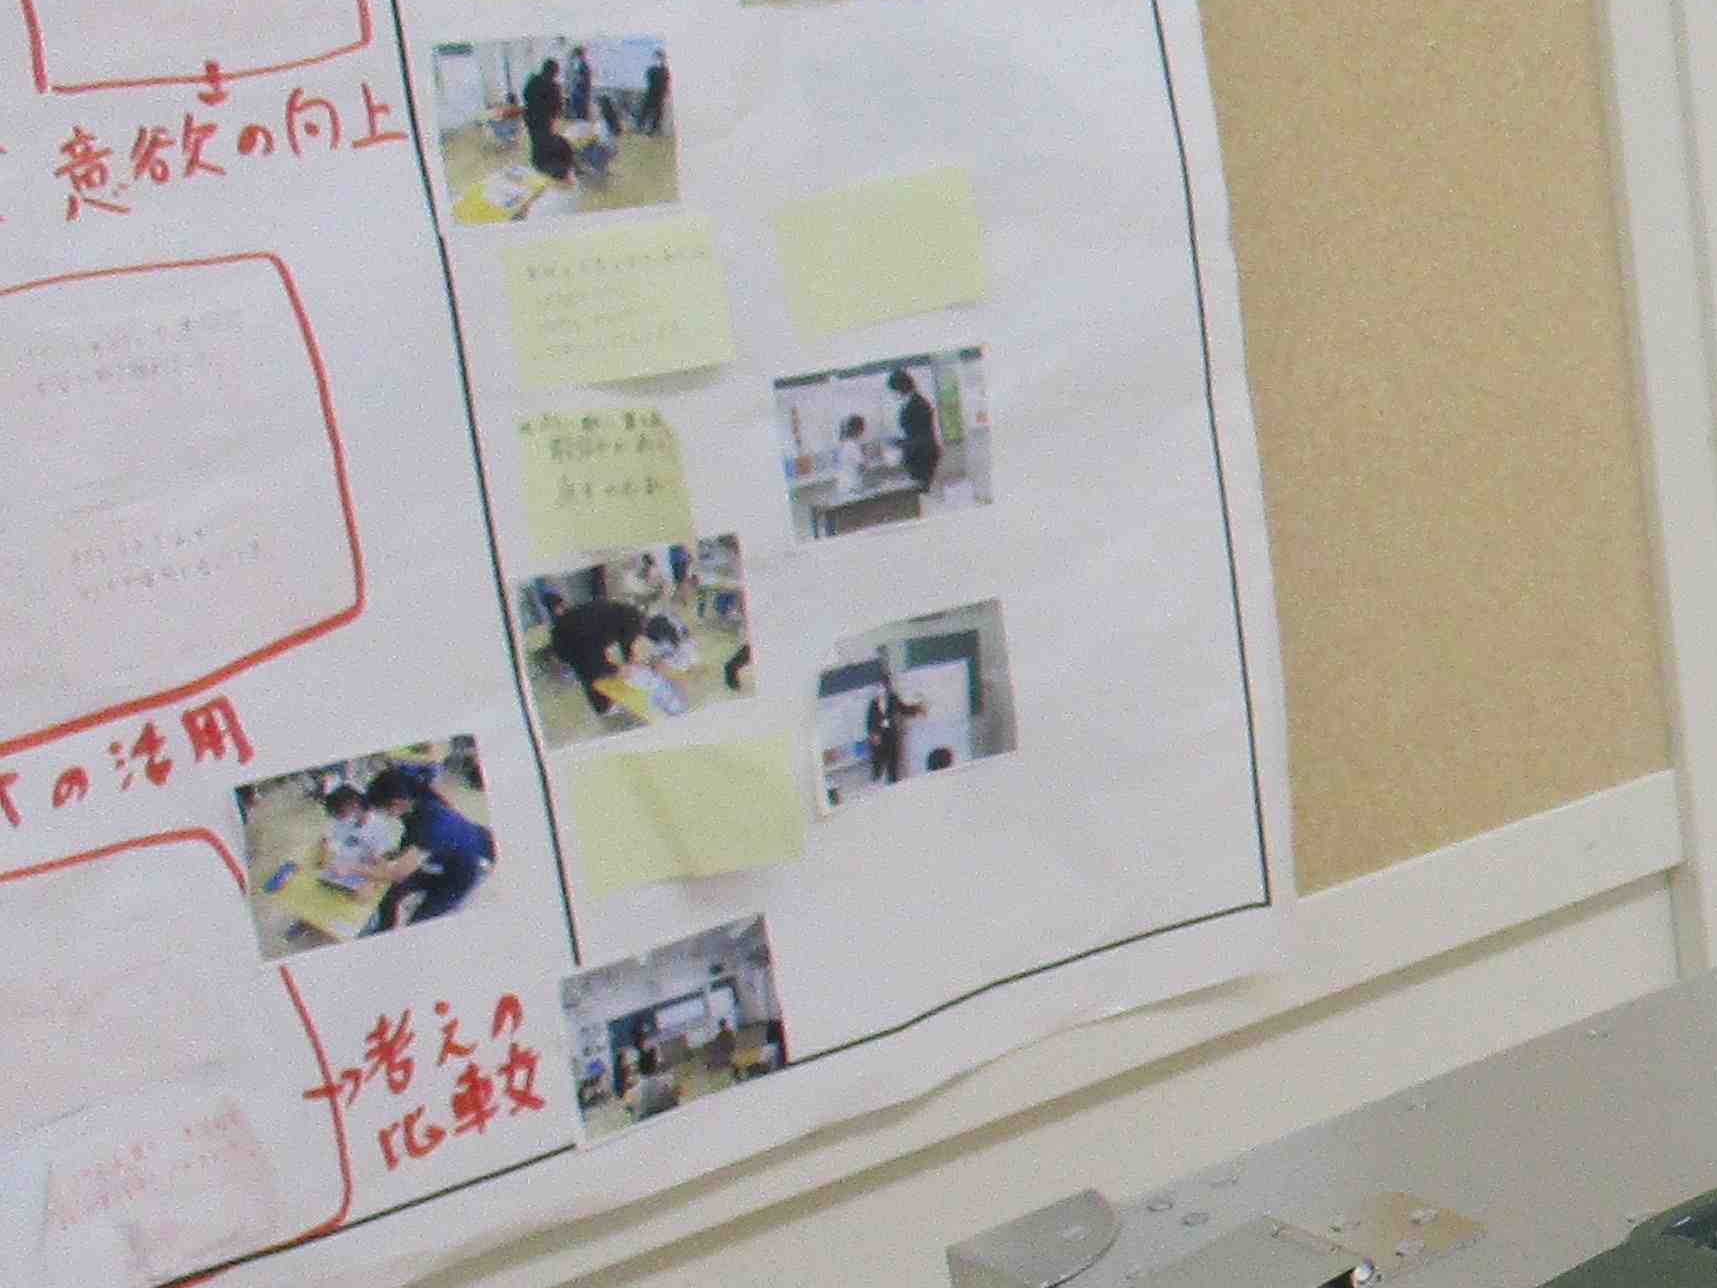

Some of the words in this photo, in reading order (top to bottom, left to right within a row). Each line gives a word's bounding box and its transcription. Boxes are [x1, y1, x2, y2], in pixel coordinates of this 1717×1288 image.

[53, 80, 410, 222] 意欲の向上
[364, 993, 523, 1094] 考えの
[377, 1042, 546, 1171] 比較
